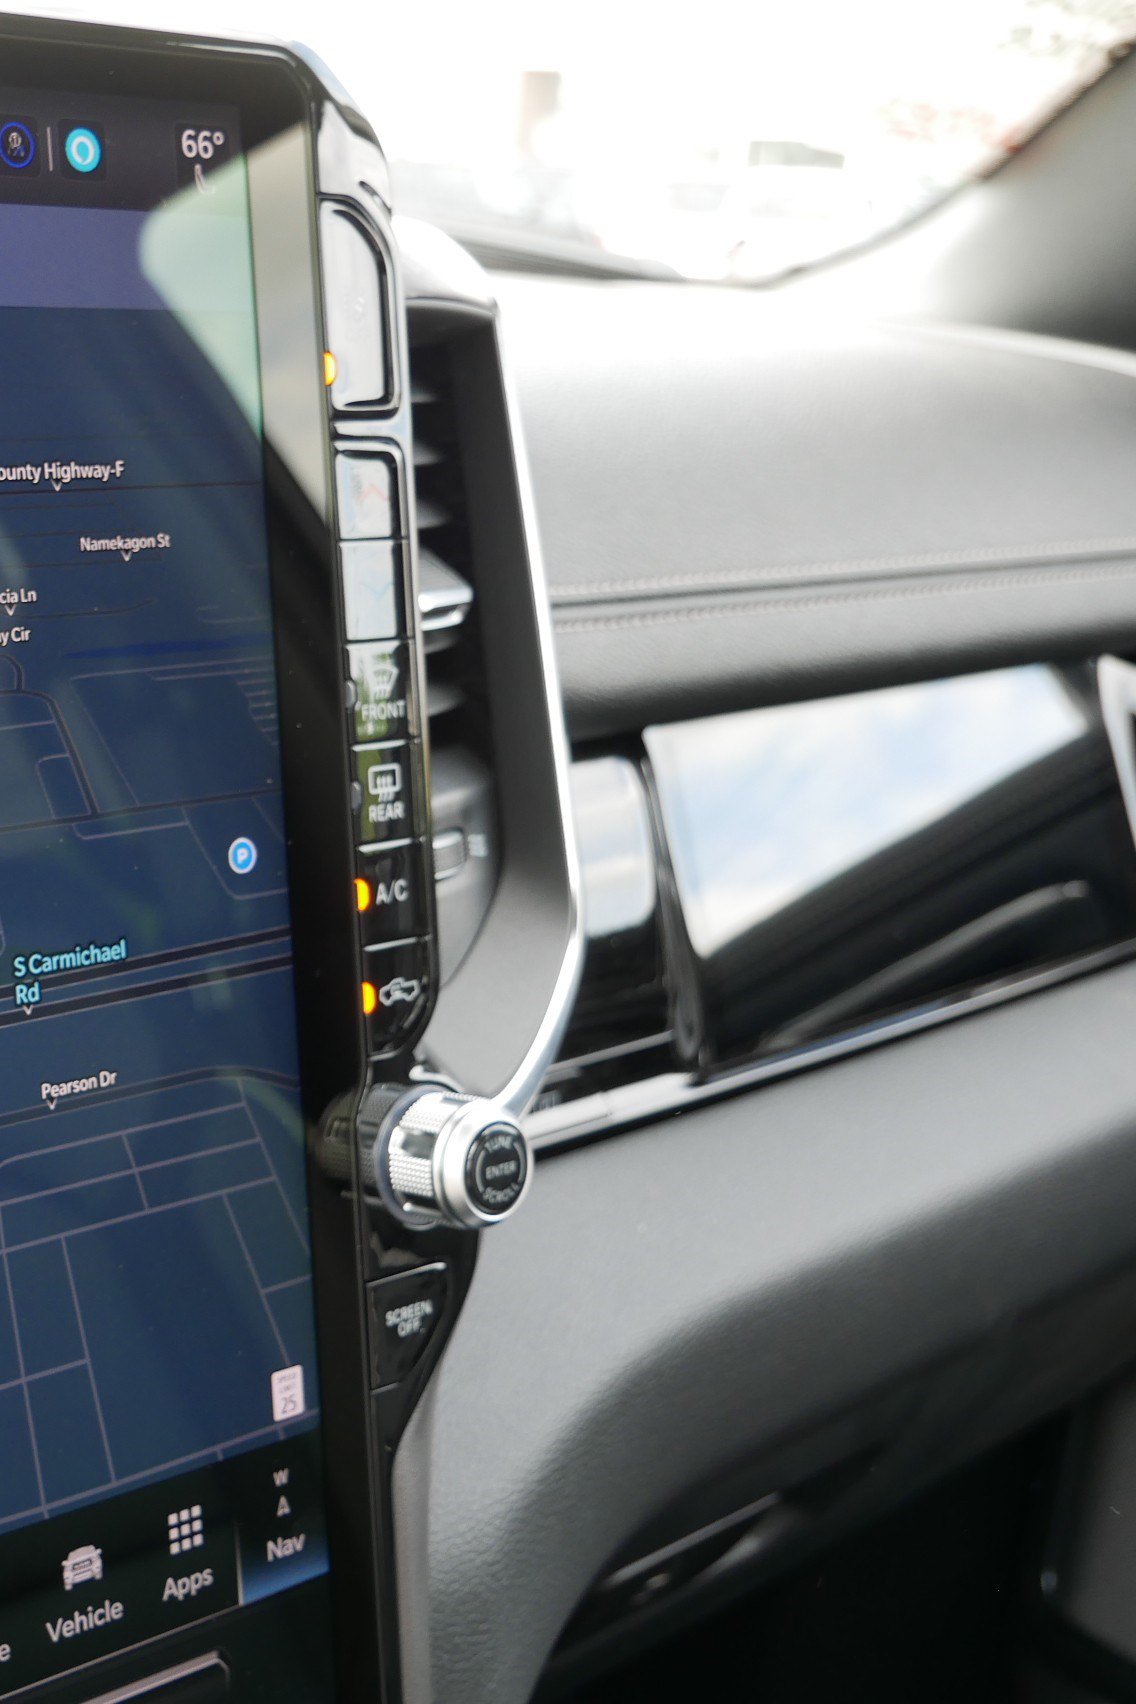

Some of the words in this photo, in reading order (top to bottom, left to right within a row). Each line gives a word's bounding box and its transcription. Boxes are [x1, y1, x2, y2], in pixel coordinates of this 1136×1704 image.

[181, 129, 225, 160] 66°
[44, 459, 125, 482] Highway-F
[79, 535, 156, 553] Namekagon
[157, 533, 172, 549] St
[21, 588, 37, 603] Ln
[10, 627, 31, 643] Cir
[361, 700, 406, 721] FRONT
[369, 802, 405, 823] REAR
[237, 848, 249, 865] P
[376, 879, 409, 904] A/C
[14, 957, 27, 977] S
[28, 939, 127, 974] Carmichael
[15, 982, 41, 1004] Rd
[41, 1074, 98, 1100] Pearson
[100, 1070, 117, 1088] Dr
[485, 1160, 517, 1180] ENTER
[385, 1299, 433, 1327] SCREEN
[397, 1316, 421, 1338] OFF
[266, 1533, 306, 1562] Nav
[162, 1565, 214, 1601] Apps
[45, 1599, 124, 1643] Vehicle
